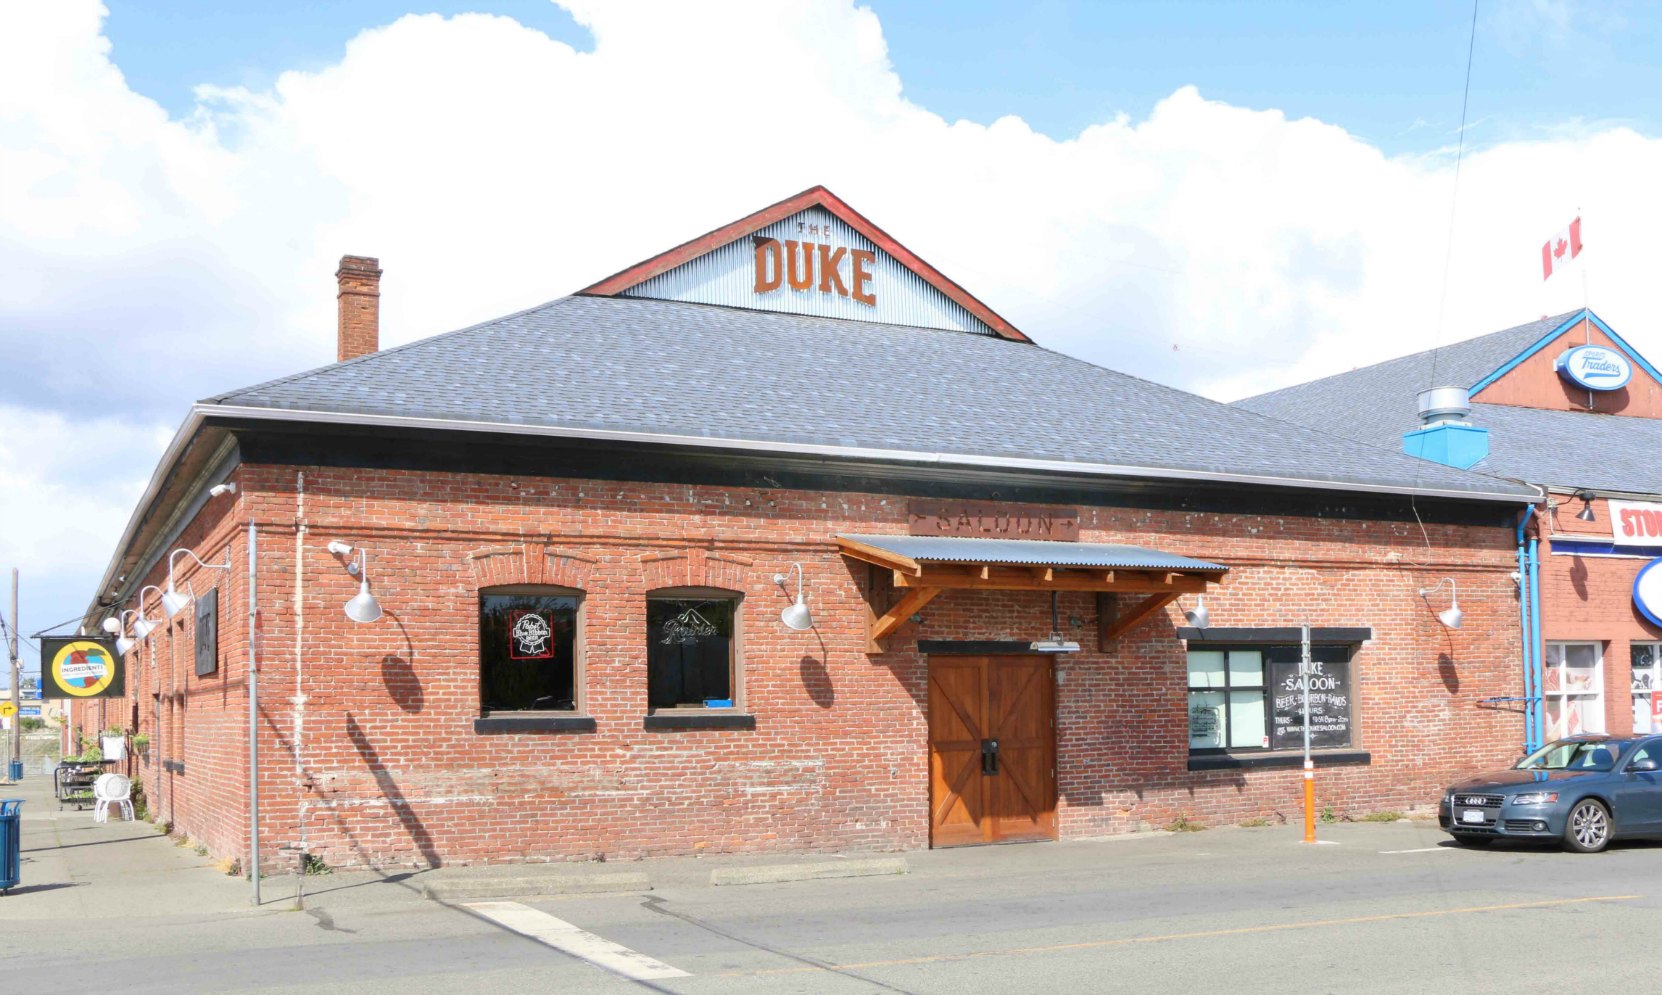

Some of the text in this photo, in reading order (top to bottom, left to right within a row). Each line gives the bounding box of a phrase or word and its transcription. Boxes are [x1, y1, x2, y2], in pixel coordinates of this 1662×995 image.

[798, 222, 830, 237] THE
[754, 238, 876, 307] DUKE
[1582, 356, 1621, 373] Traders
[936, 509, 1053, 535] SALOON
[521, 620, 541, 631] Pabst
[1298, 662, 1323, 676] DKE
[1286, 678, 1335, 690] SAOON
[1276, 695, 1296, 708] BEER
[1328, 694, 1346, 706] BANDS
